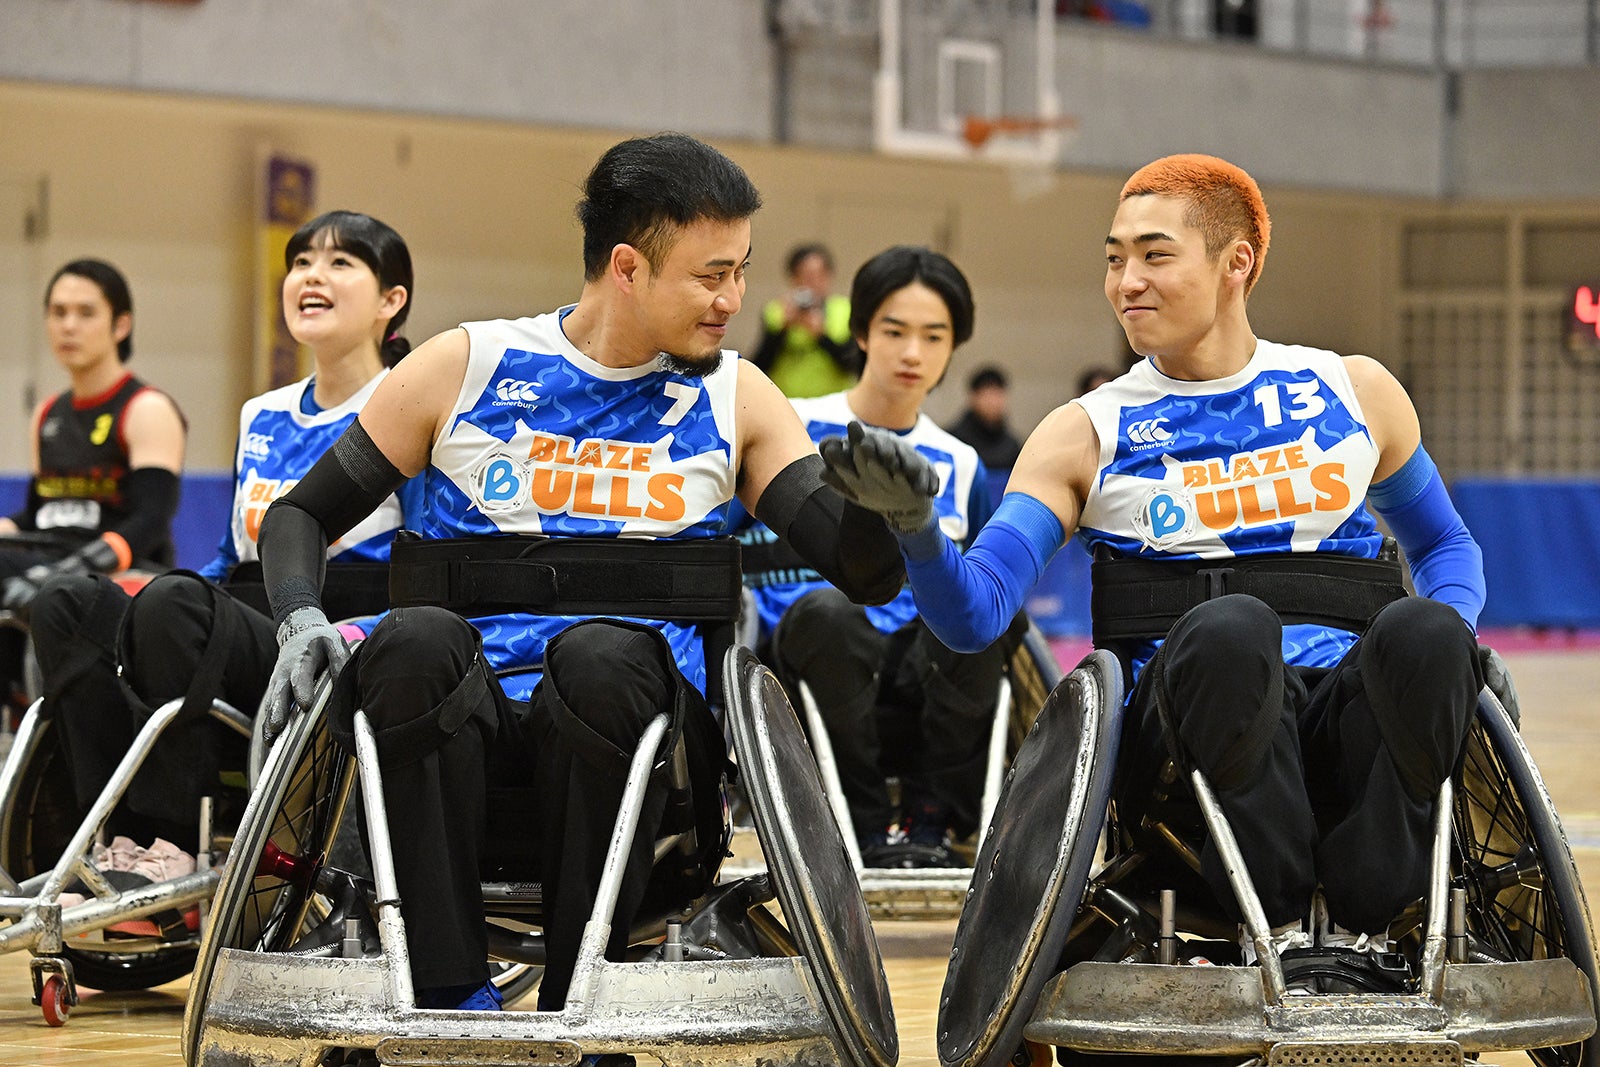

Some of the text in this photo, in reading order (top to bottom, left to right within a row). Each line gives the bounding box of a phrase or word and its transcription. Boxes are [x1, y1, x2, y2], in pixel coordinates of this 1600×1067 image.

[491, 400, 538, 412] canterbury
[657, 381, 701, 426] 7
[1253, 378, 1326, 428] 13
[529, 435, 652, 472] BLAZE
[1129, 440, 1176, 452] canterbury
[1182, 445, 1309, 488] BLAZE
